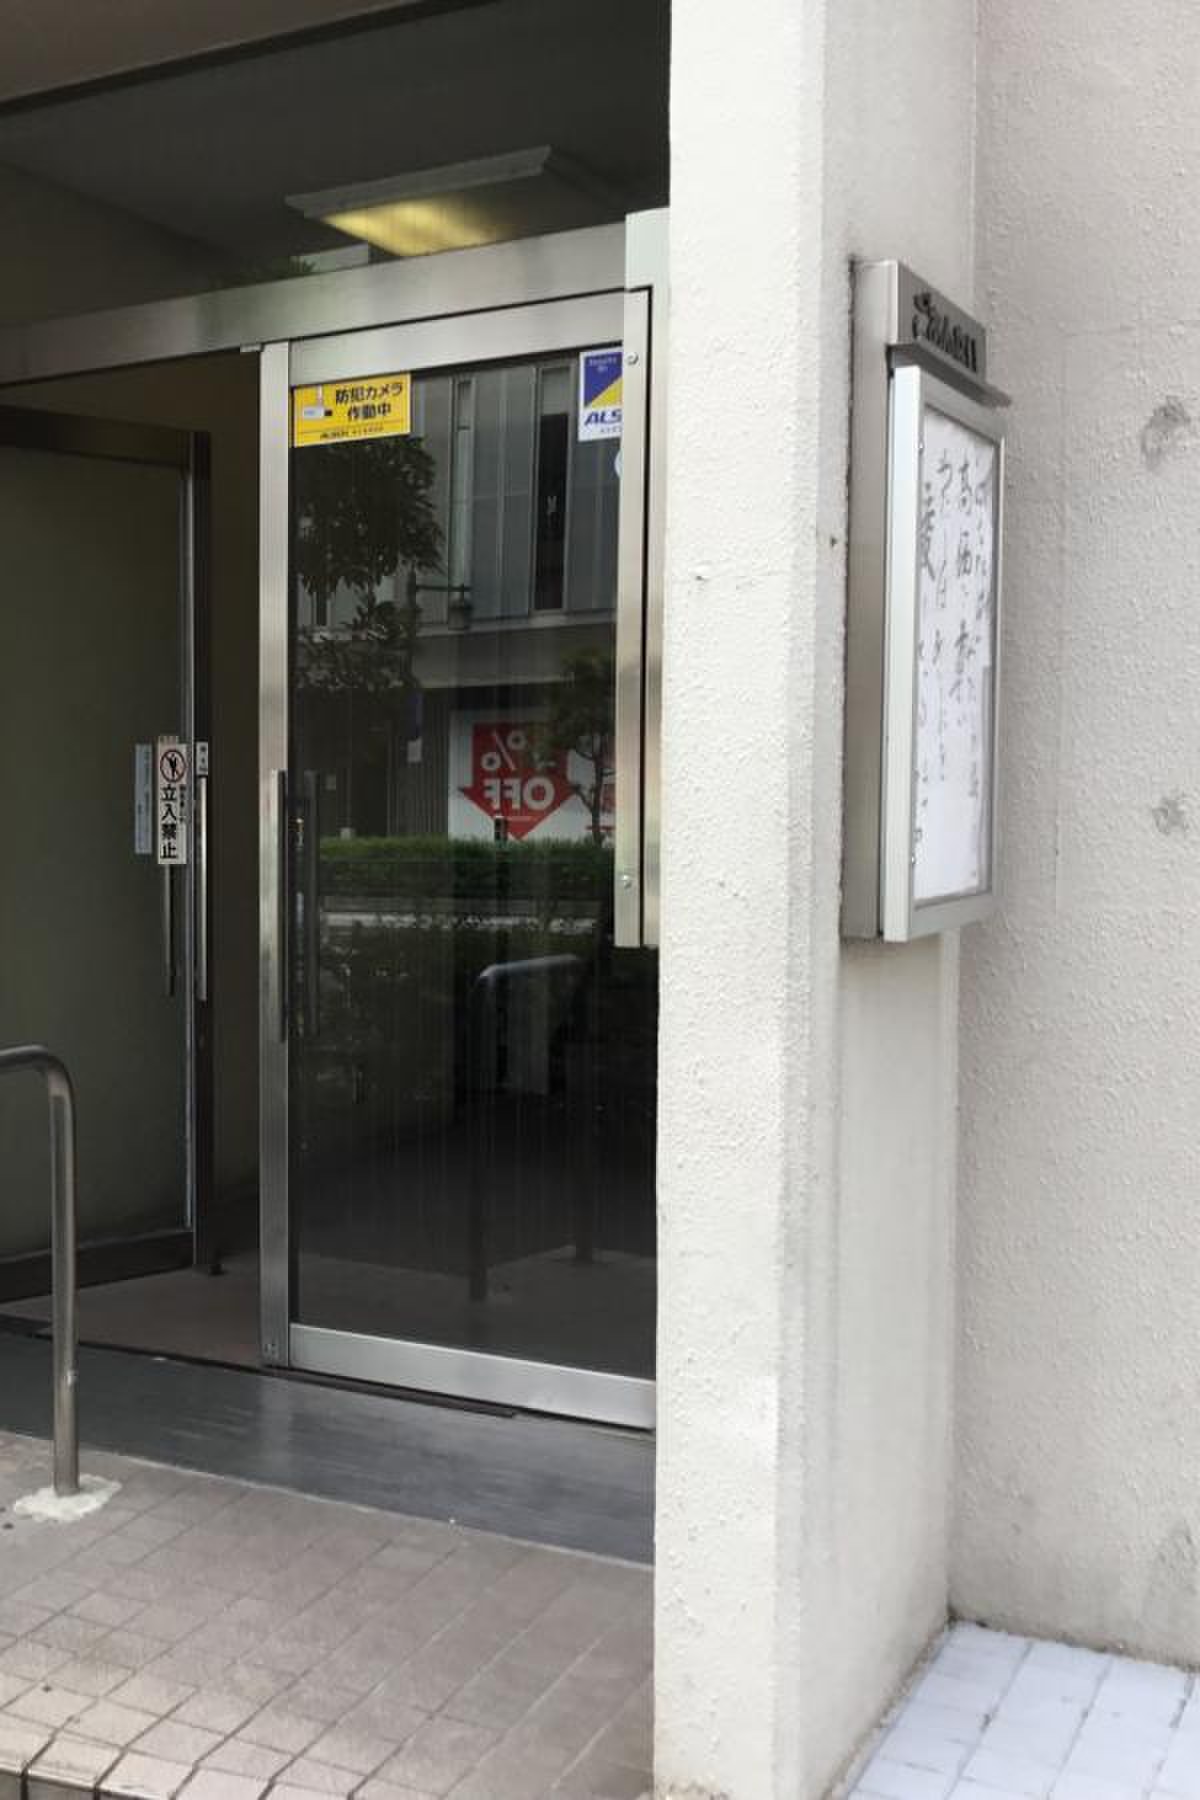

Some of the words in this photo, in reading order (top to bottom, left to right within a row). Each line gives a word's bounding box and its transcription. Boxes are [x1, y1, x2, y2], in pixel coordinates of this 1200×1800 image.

[336, 382, 403, 405] 防犯カメラ
[347, 402, 392, 421] 作動中
[160, 783, 177, 859] 立入禁止
